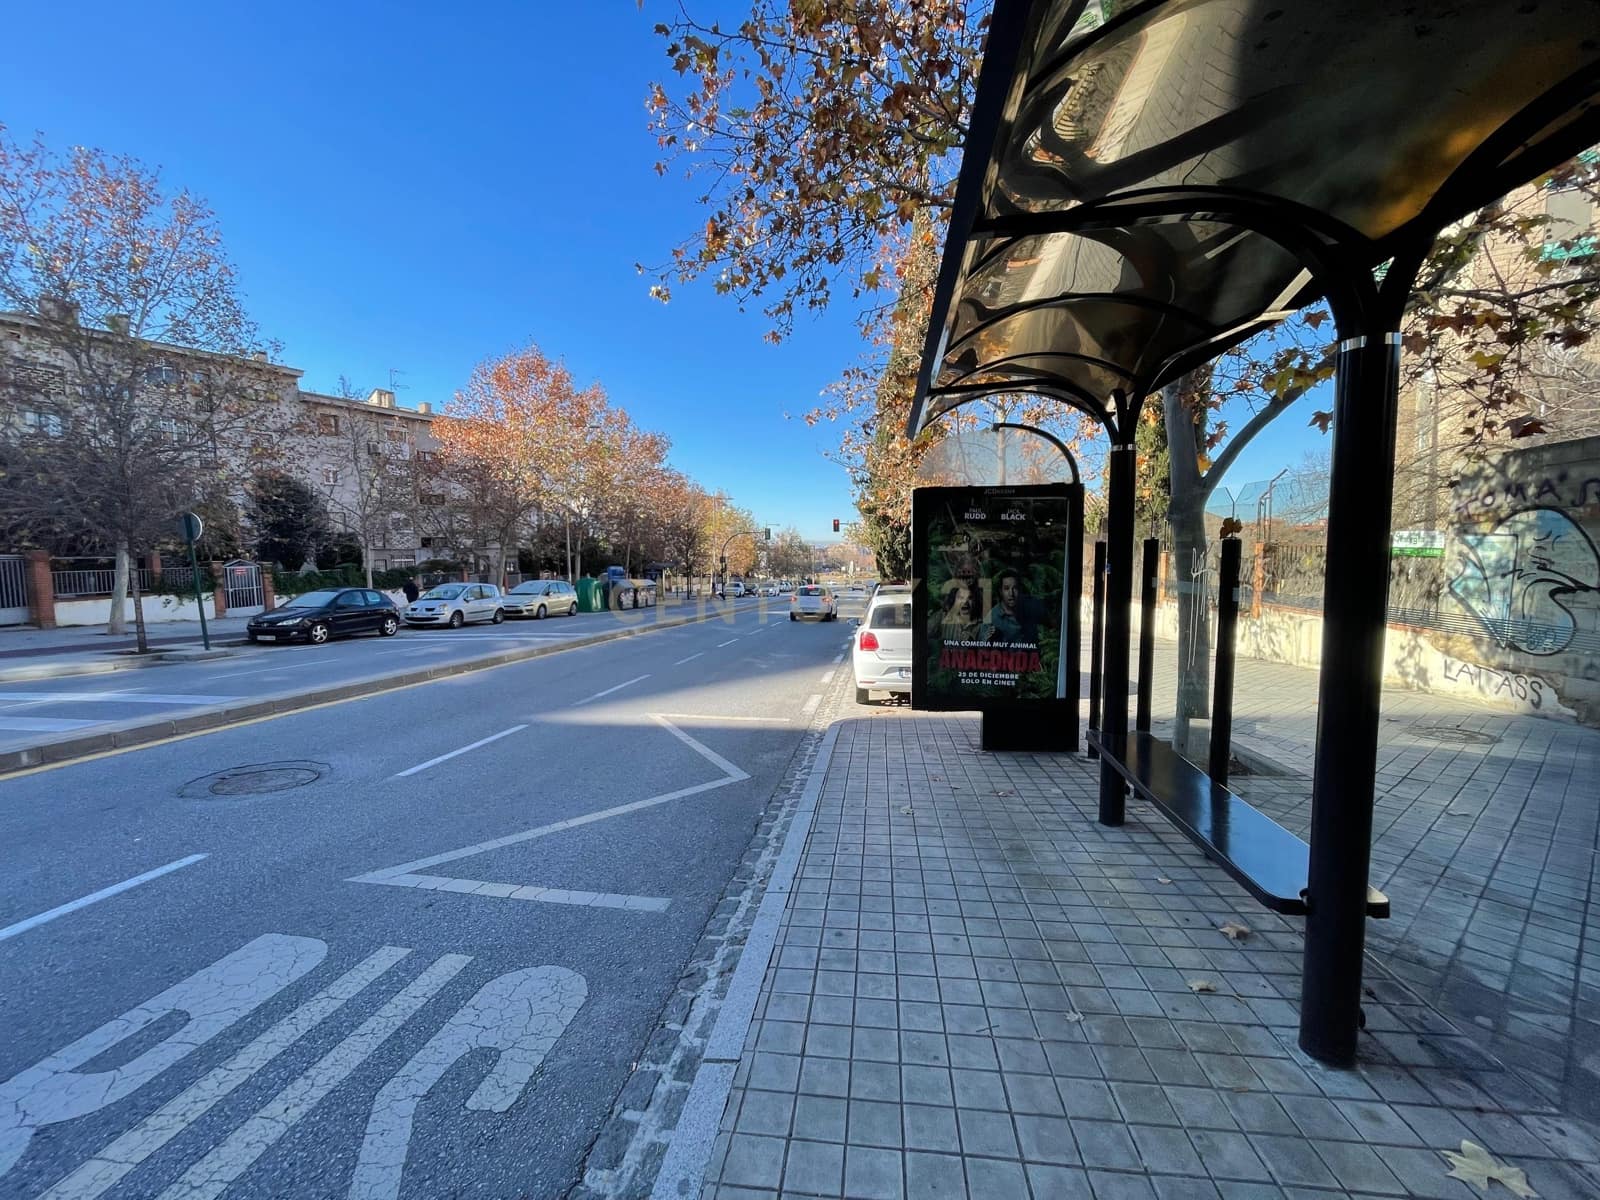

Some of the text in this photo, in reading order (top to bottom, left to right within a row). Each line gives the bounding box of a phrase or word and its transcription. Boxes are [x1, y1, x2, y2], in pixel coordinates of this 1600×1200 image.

[964, 512, 987, 520] RUDD
[1000, 513, 1026, 521] BLACK
[943, 639, 959, 647] UNA
[960, 640, 991, 648] COMEDIA
[939, 648, 1041, 671] ANACONDA
[979, 672, 1019, 680] DICIEMBRE
